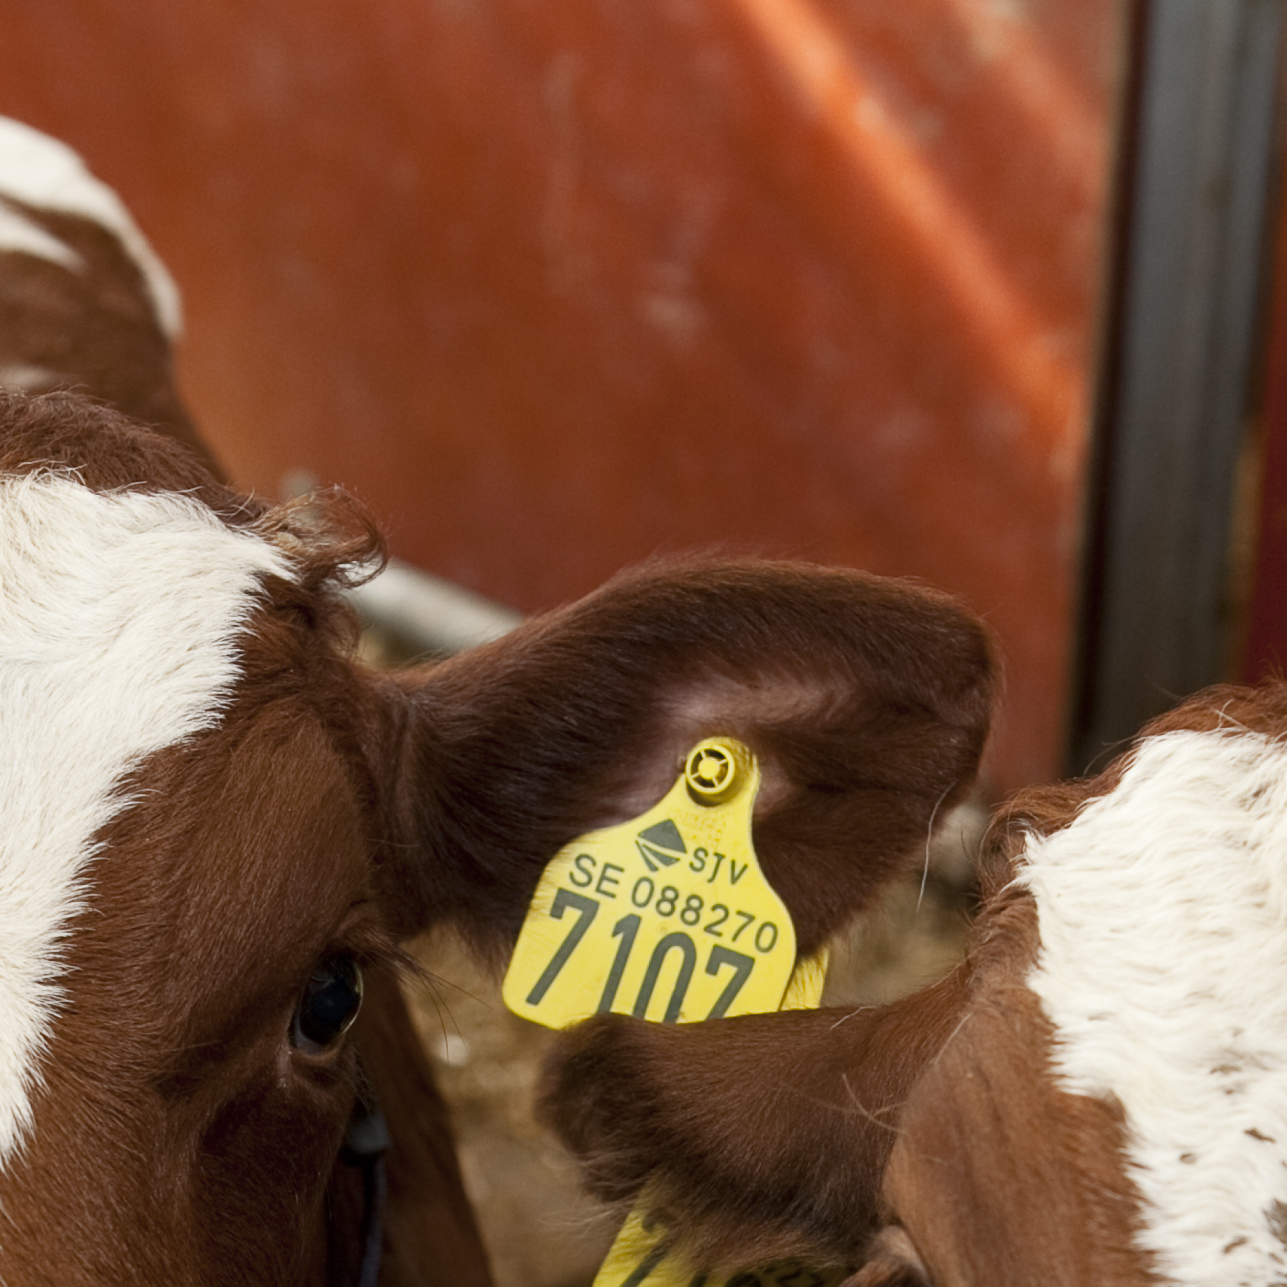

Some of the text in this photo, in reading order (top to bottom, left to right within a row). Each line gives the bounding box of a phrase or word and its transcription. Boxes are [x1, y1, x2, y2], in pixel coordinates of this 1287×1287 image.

[689, 847, 748, 885] SJV
[569, 853, 778, 953] SE 088270
